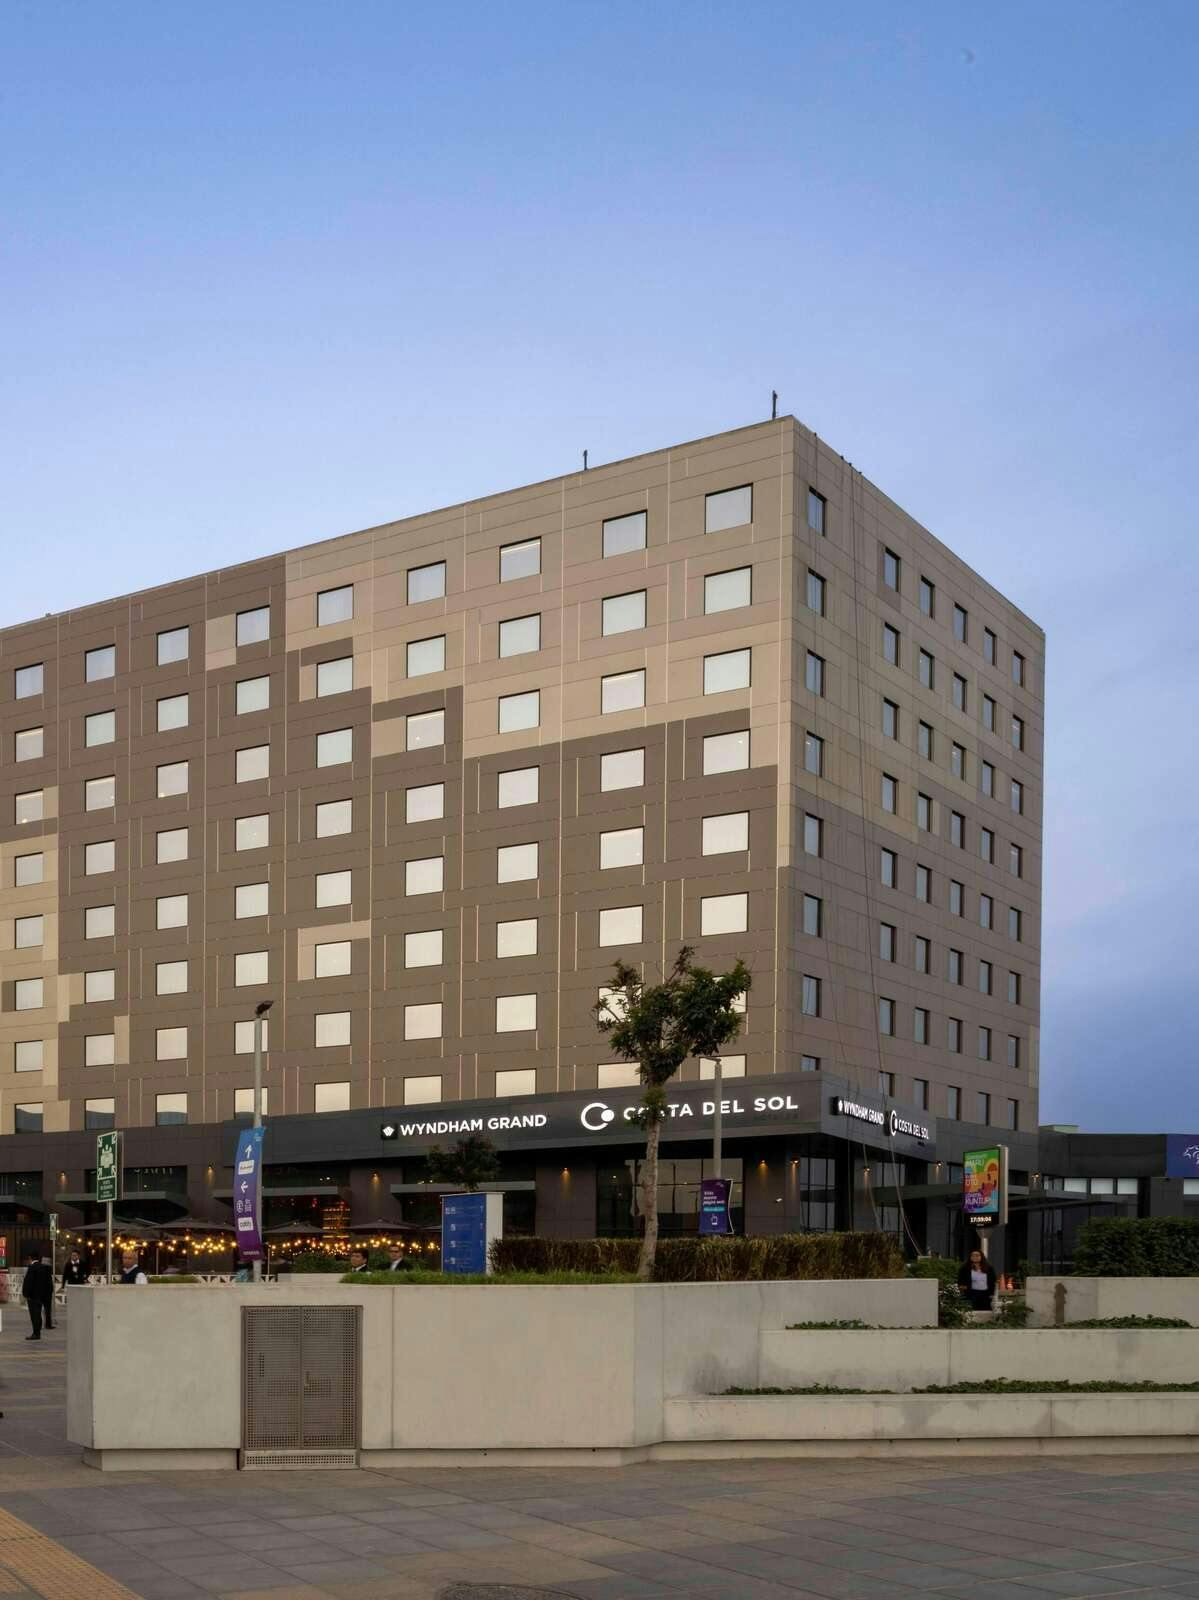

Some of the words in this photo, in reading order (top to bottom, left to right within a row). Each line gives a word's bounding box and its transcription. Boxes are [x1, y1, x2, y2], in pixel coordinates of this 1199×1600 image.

[701, 1099, 745, 1116] DEL
[753, 1095, 799, 1112] SOL
[843, 1100, 869, 1120] WYNDHAM
[869, 1108, 885, 1126] GRAND
[400, 1118, 484, 1137] WYNDHAM
[487, 1114, 548, 1131] GRAND
[898, 1119, 913, 1135] COSTA
[913, 1123, 921, 1137] DEL
[921, 1125, 930, 1140] SOL
